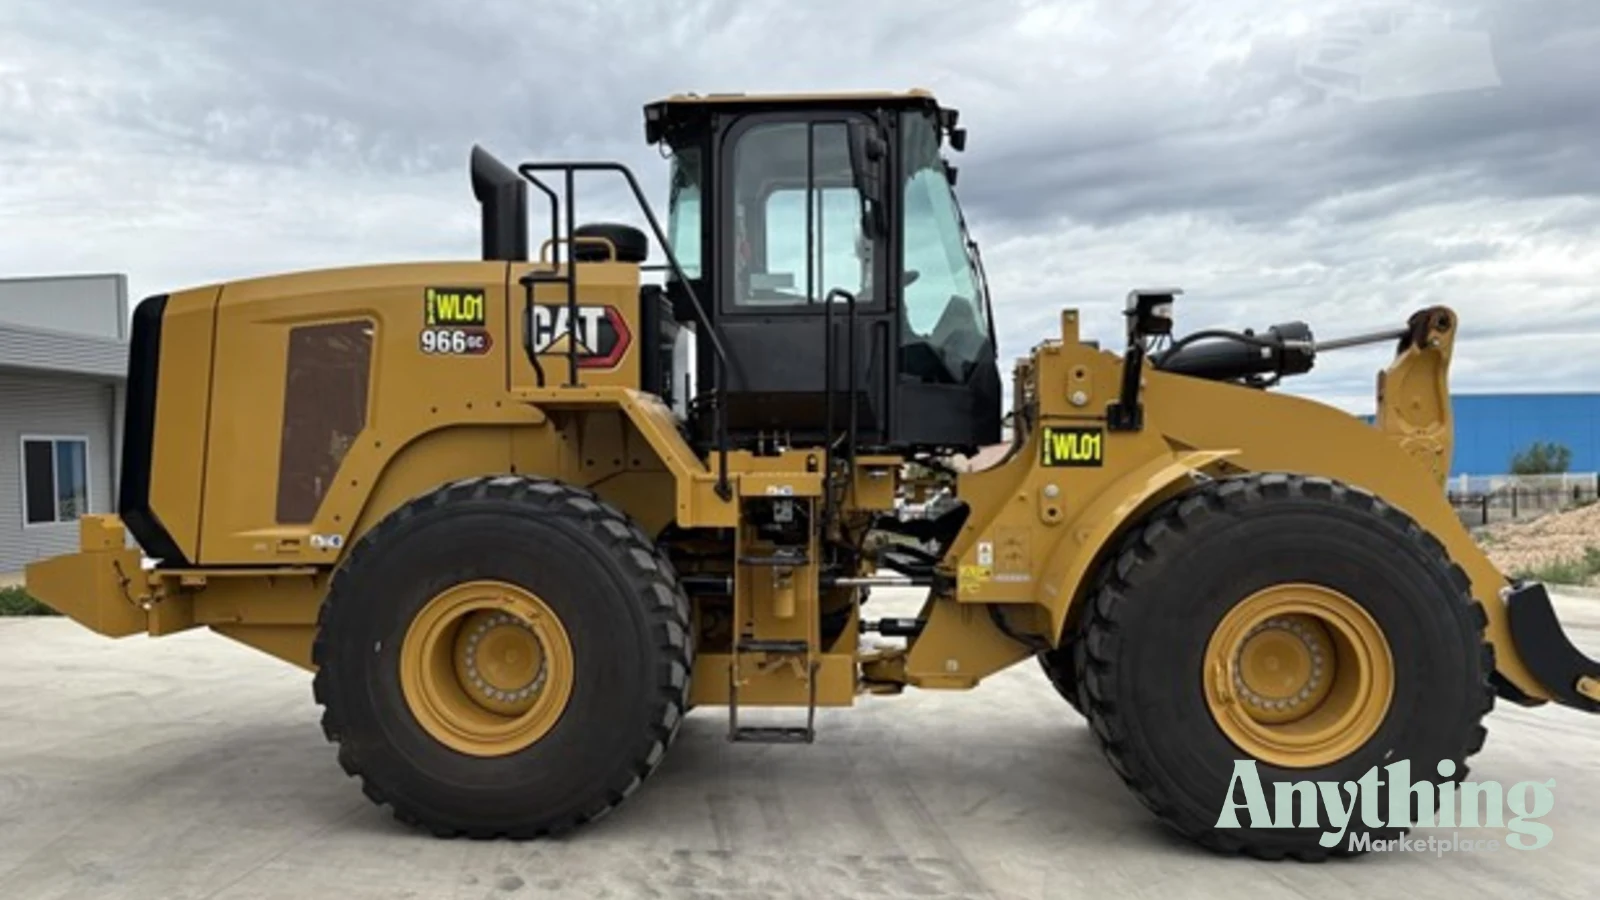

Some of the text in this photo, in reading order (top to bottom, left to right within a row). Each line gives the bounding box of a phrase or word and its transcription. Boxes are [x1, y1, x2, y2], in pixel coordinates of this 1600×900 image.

[437, 294, 483, 321] WL01
[533, 305, 605, 354] CAT
[1052, 433, 1101, 460] WL01
